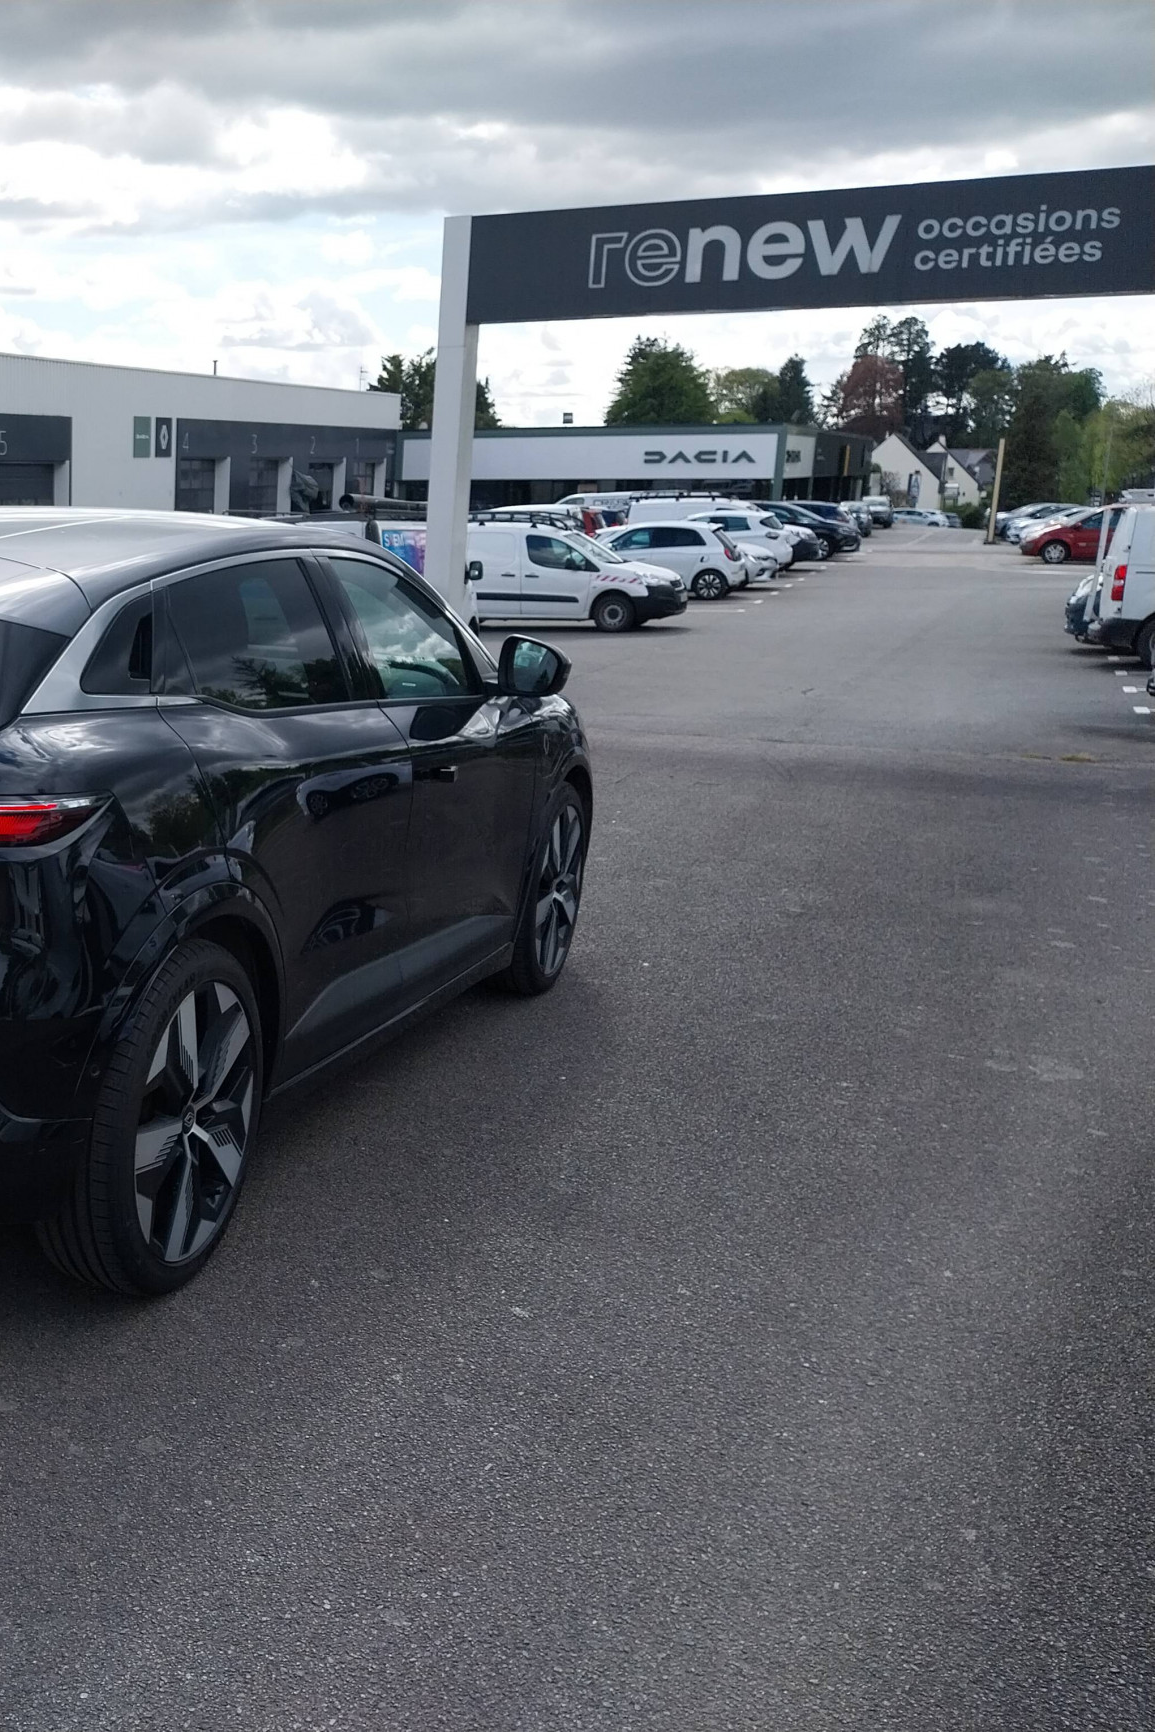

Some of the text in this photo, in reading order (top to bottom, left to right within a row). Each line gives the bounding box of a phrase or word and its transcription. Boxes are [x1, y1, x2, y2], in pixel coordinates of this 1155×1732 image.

[917, 203, 1122, 240] occasions
[587, 214, 903, 289] renew
[913, 235, 1103, 271] certifiées
[182, 432, 189, 452] 4
[250, 434, 258, 454] 3
[310, 436, 316, 454] 2
[644, 450, 756, 464] DACIA
